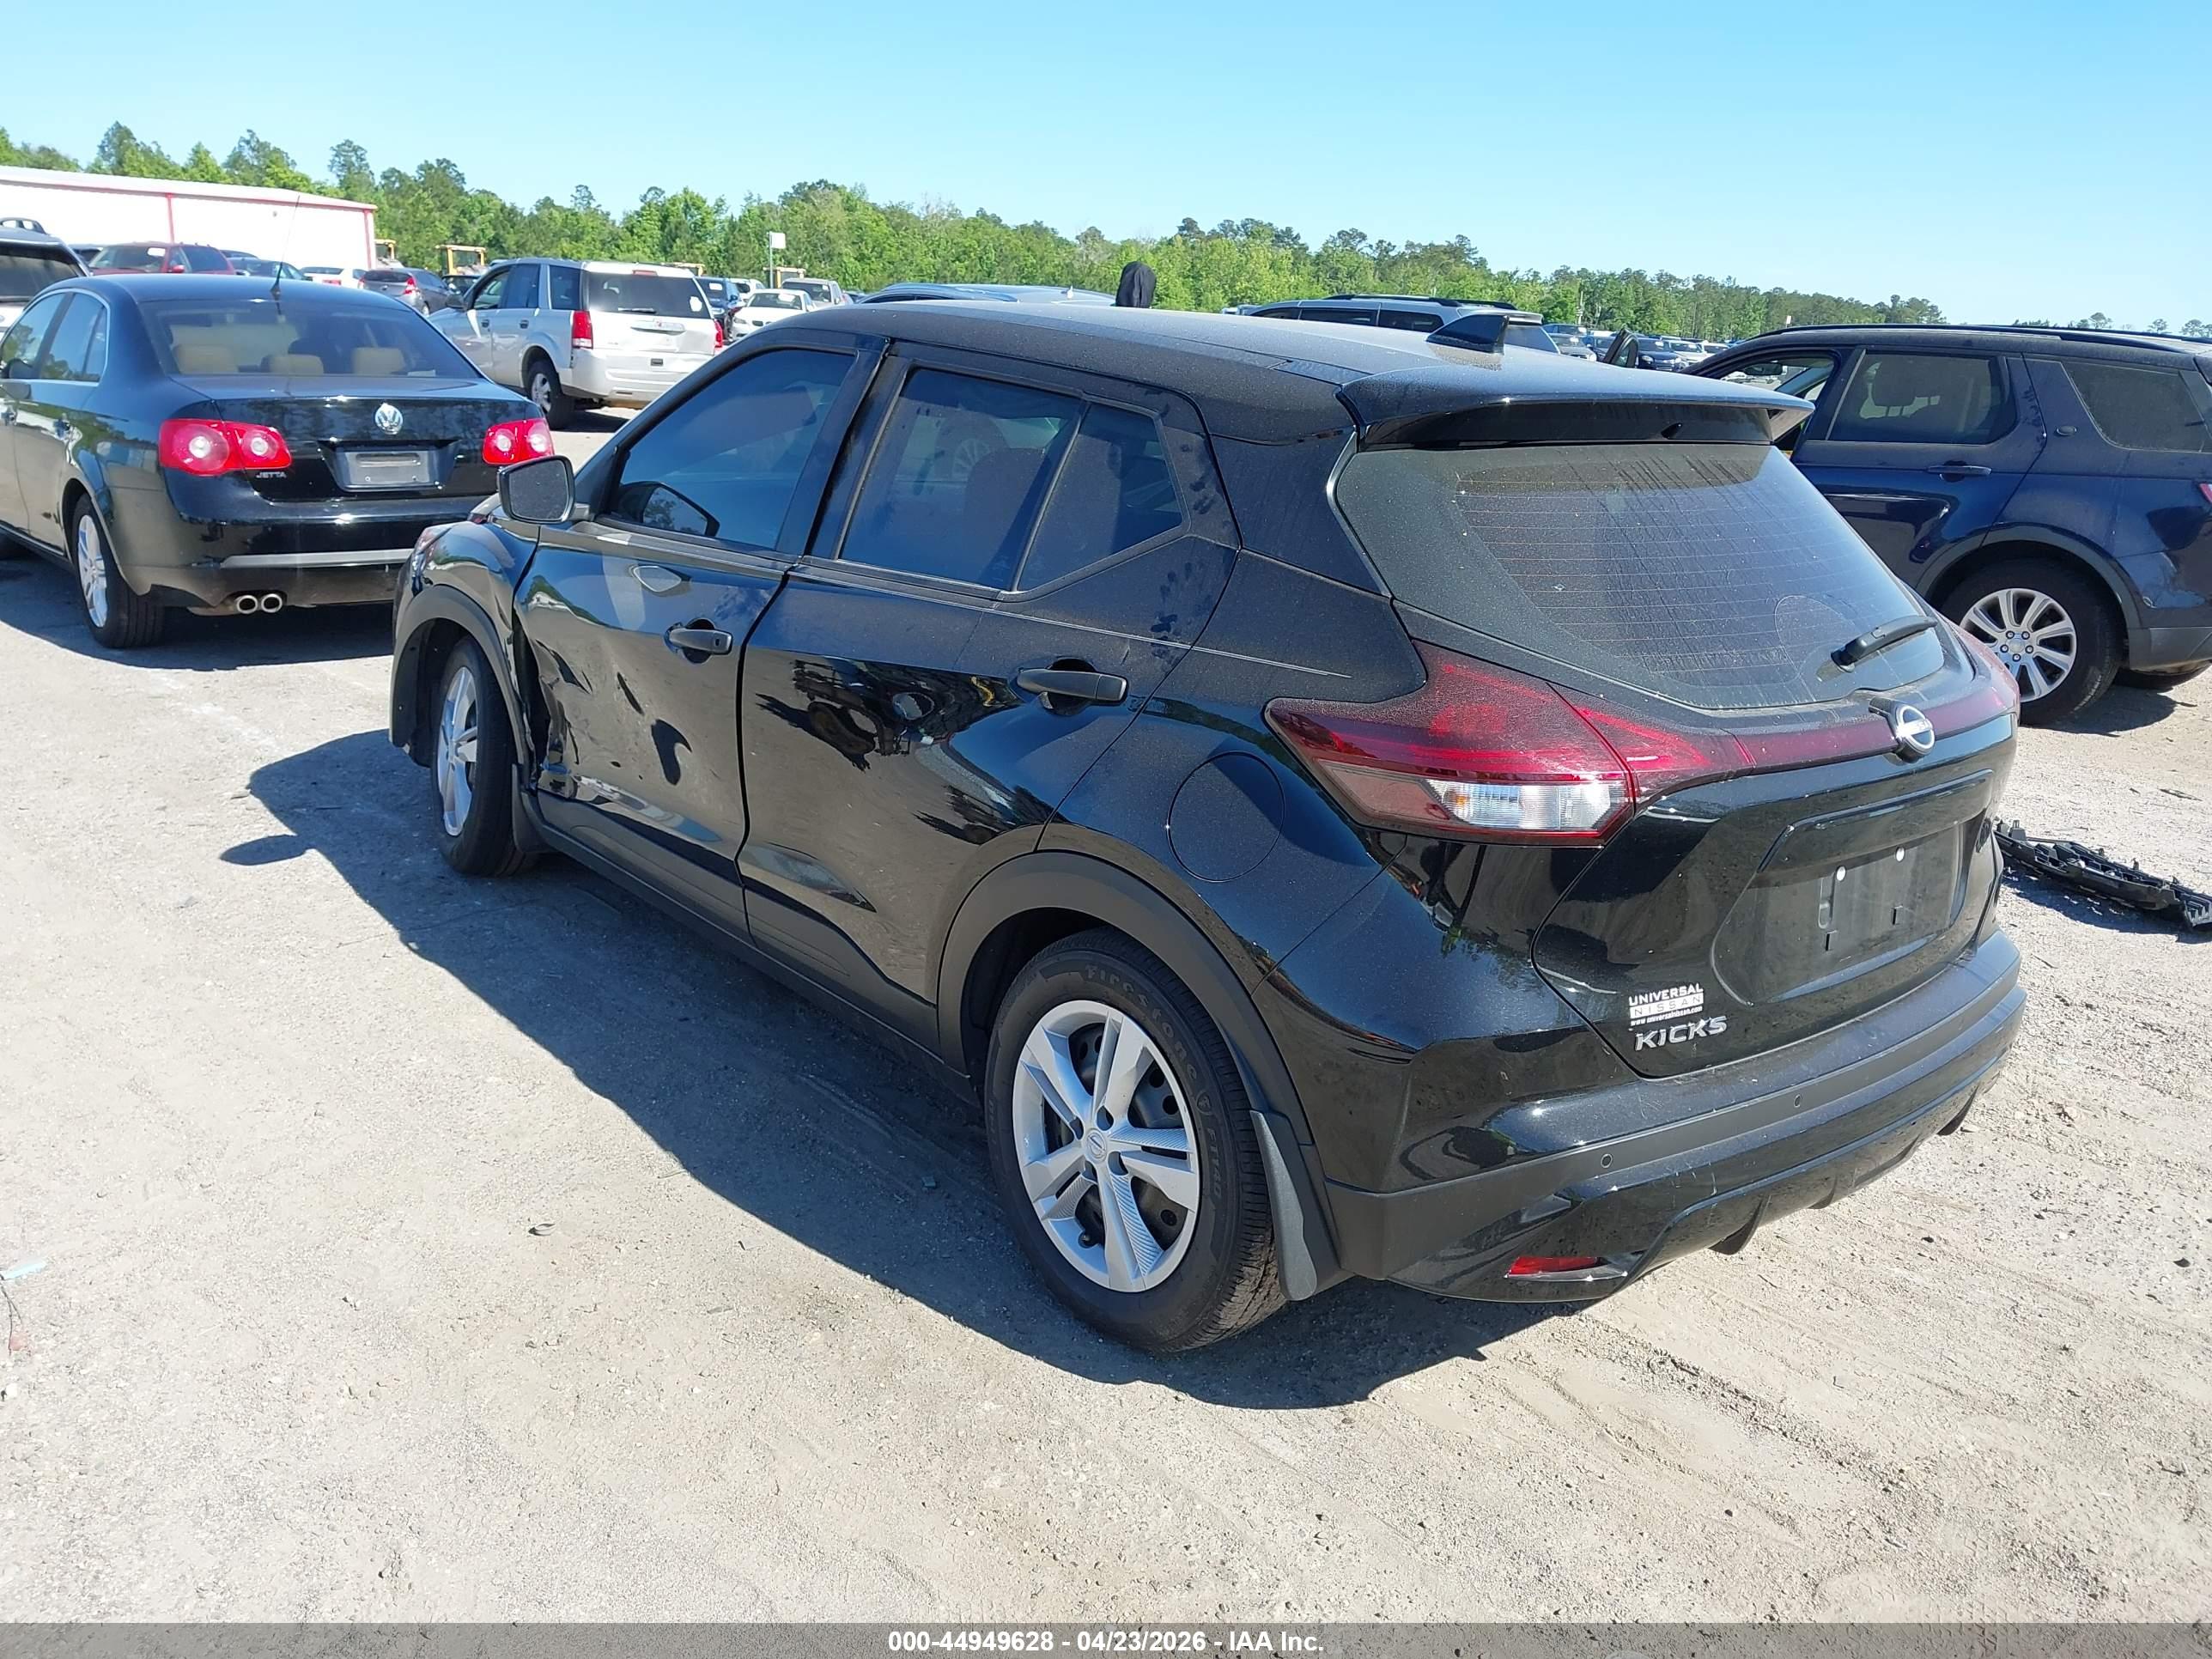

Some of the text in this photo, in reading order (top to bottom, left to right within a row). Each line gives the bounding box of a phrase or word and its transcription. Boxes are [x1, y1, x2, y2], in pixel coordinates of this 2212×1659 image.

[1629, 983, 1704, 1006] UNIVERSAL
[1634, 995, 1700, 1017] NISSAN
[1085, 963, 1197, 1080] Firestone
[1634, 1015, 1728, 1052] KICKS
